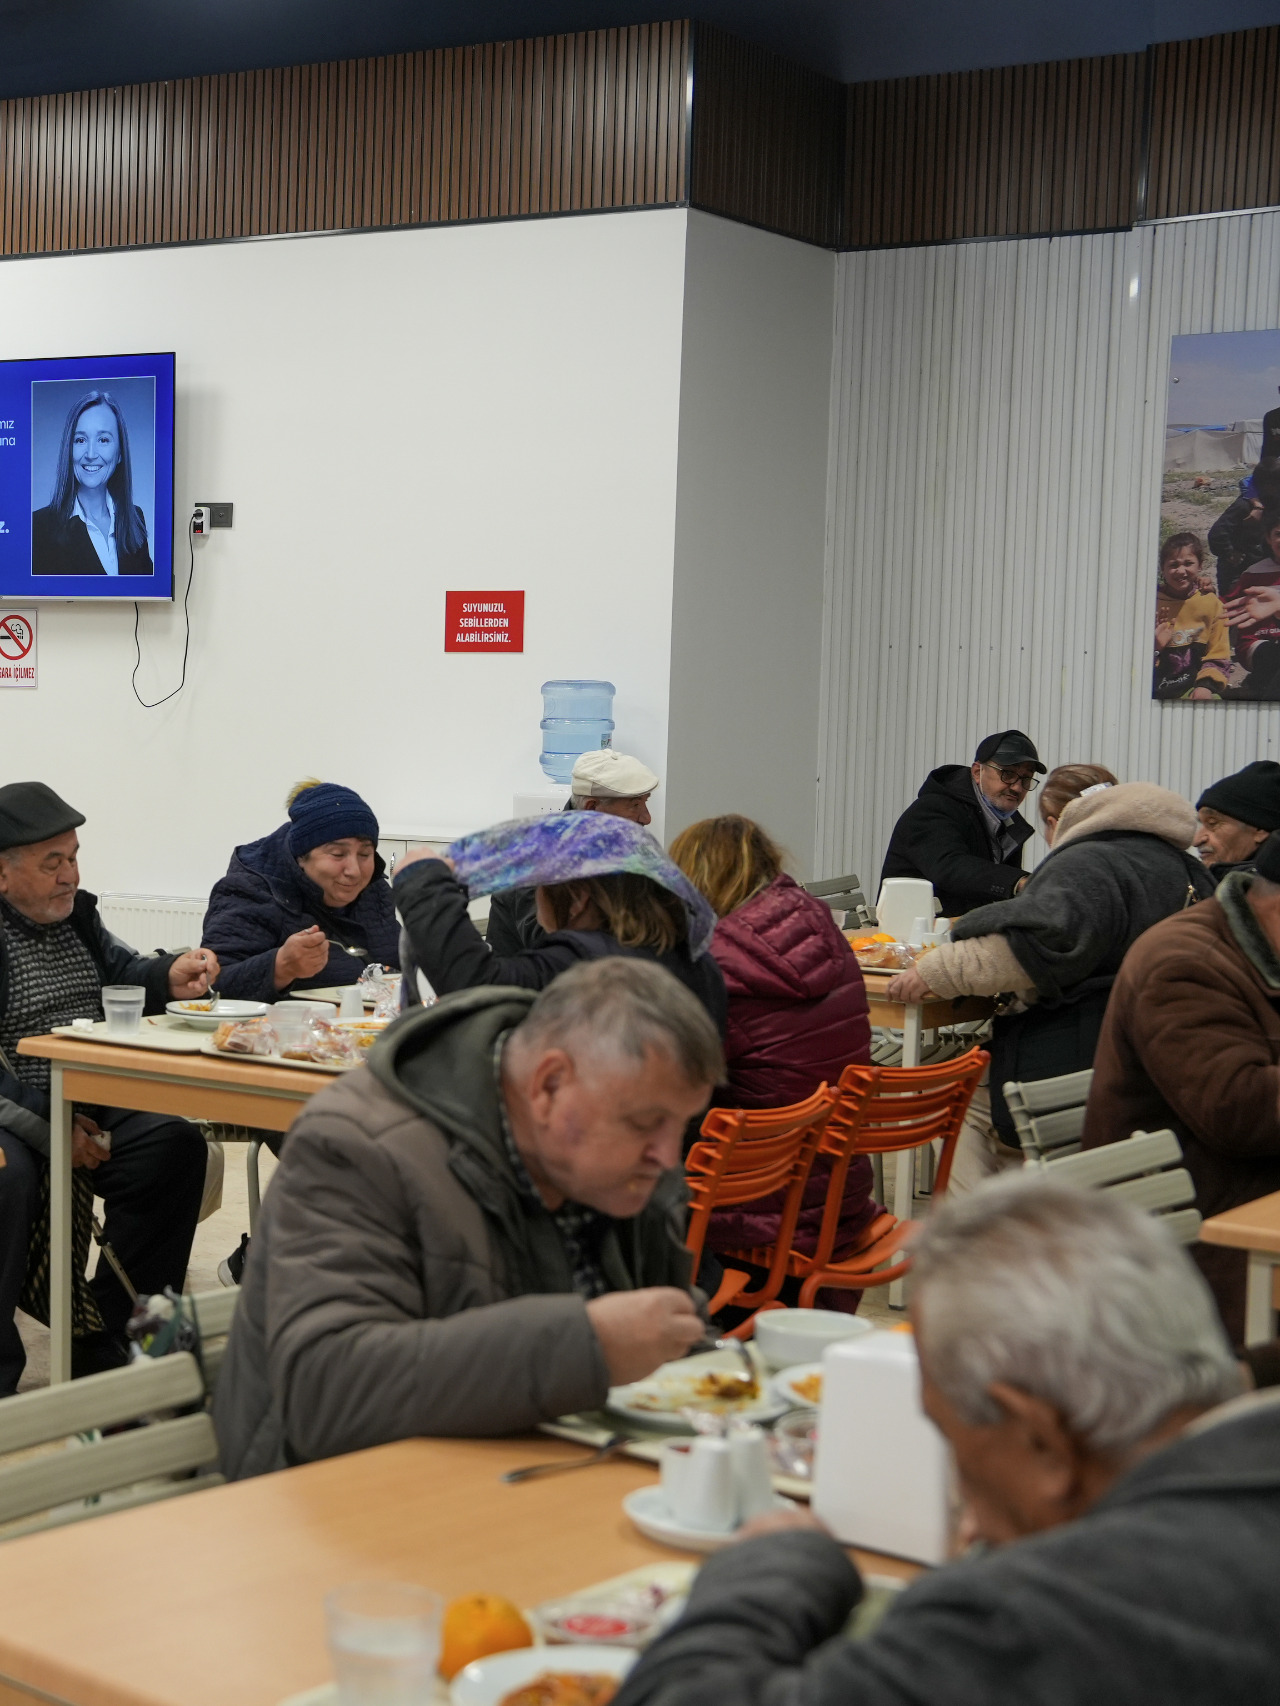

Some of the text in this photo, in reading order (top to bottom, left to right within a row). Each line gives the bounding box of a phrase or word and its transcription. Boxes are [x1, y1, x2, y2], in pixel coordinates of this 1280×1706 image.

[462, 602, 507, 614] SUYUNUZU,
[459, 616, 509, 628] SEBİLLERDEN
[455, 631, 512, 643] ALABİLİRSİNİZ.
[13, 664, 35, 682] İÇİLMEZ
